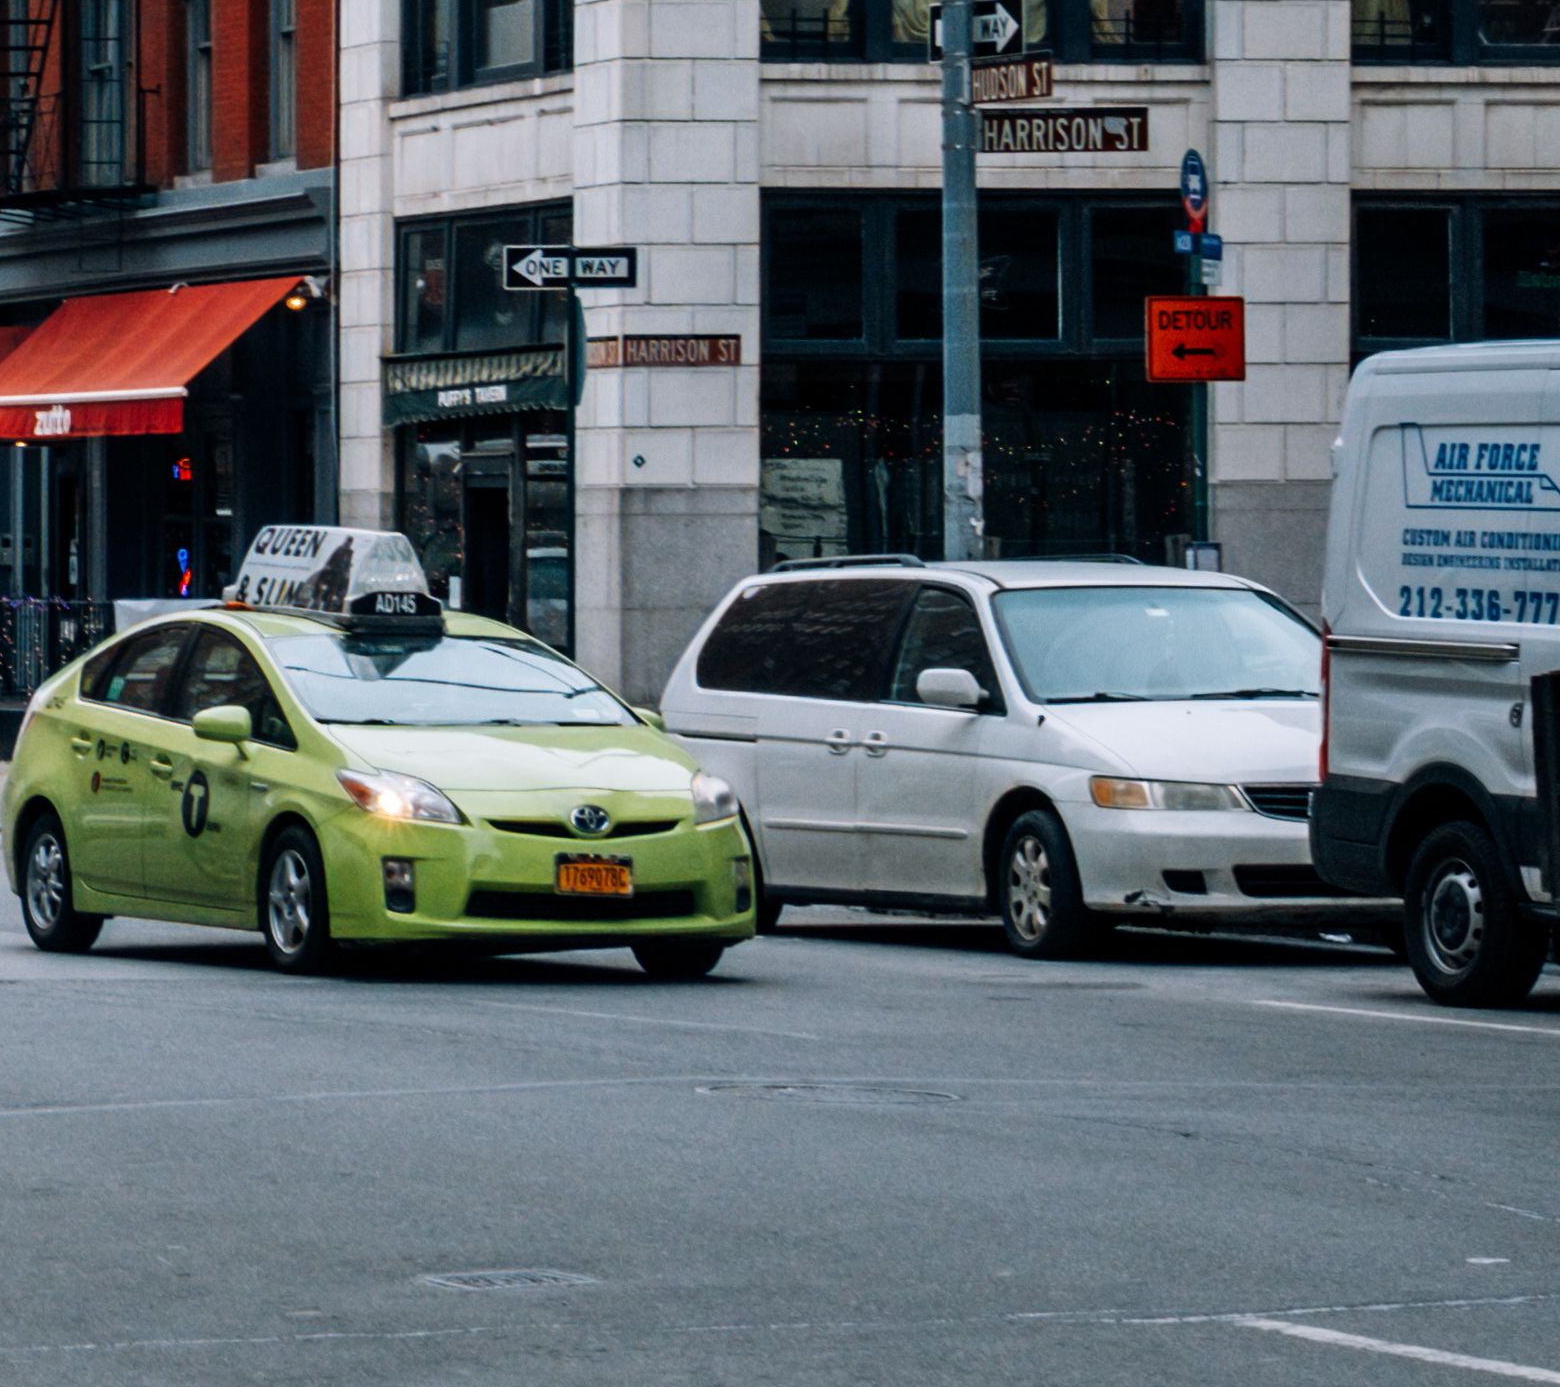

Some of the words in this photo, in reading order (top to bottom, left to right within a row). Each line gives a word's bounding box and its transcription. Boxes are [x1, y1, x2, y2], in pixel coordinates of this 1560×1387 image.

[981, 16, 1010, 39] WAY
[972, 65, 1026, 101] HUDSON
[1032, 61, 1049, 96] ST
[984, 117, 1102, 152] HARRISON
[1115, 117, 1142, 150] ST
[525, 259, 563, 276] ONE
[580, 259, 619, 275] WAY
[1159, 311, 1233, 330] DETOUR
[627, 339, 710, 362] HARRISON
[720, 339, 737, 362] ST
[34, 403, 72, 435] zutto
[1434, 443, 1470, 470] AIR
[1474, 443, 1541, 471] FORCE
[1430, 479, 1533, 504] MECHANICAL
[255, 527, 327, 558] QUEEN
[1402, 528, 1451, 547] CUSTOM
[1454, 530, 1476, 548] AIR
[1401, 552, 1434, 567] DESIGN
[235, 574, 250, 602] &
[255, 577, 305, 606] SLIM
[375, 593, 417, 614] AD145
[1400, 585, 1559, 625] 212-336-777
